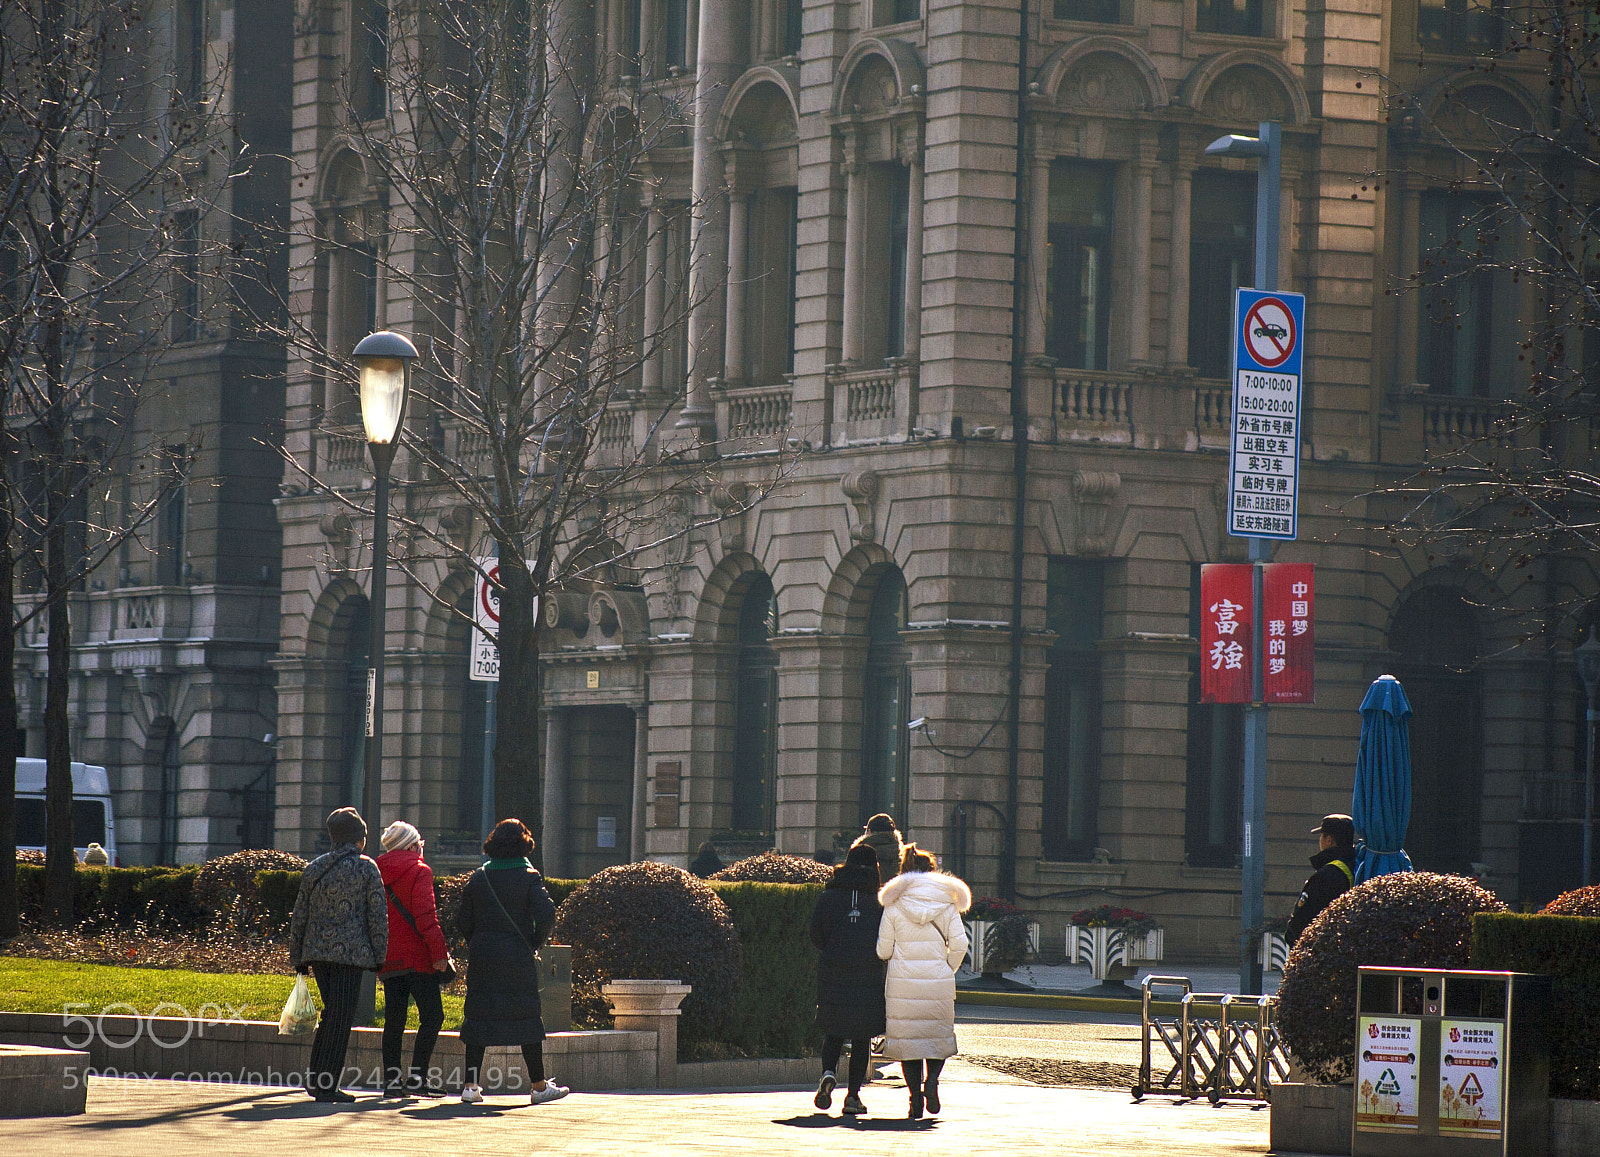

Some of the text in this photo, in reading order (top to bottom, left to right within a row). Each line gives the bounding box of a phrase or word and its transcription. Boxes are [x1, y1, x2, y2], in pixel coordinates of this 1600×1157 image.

[1239, 417, 1293, 435] 外省市号牌
[1243, 437, 1288, 453] 出租空车
[1249, 456, 1283, 472] 实习车
[1242, 475, 1287, 493] 临时号牌
[1236, 515, 1290, 532] 延安东路隧道
[1292, 581, 1308, 636] 中国梦
[1269, 619, 1285, 674] 我的梦
